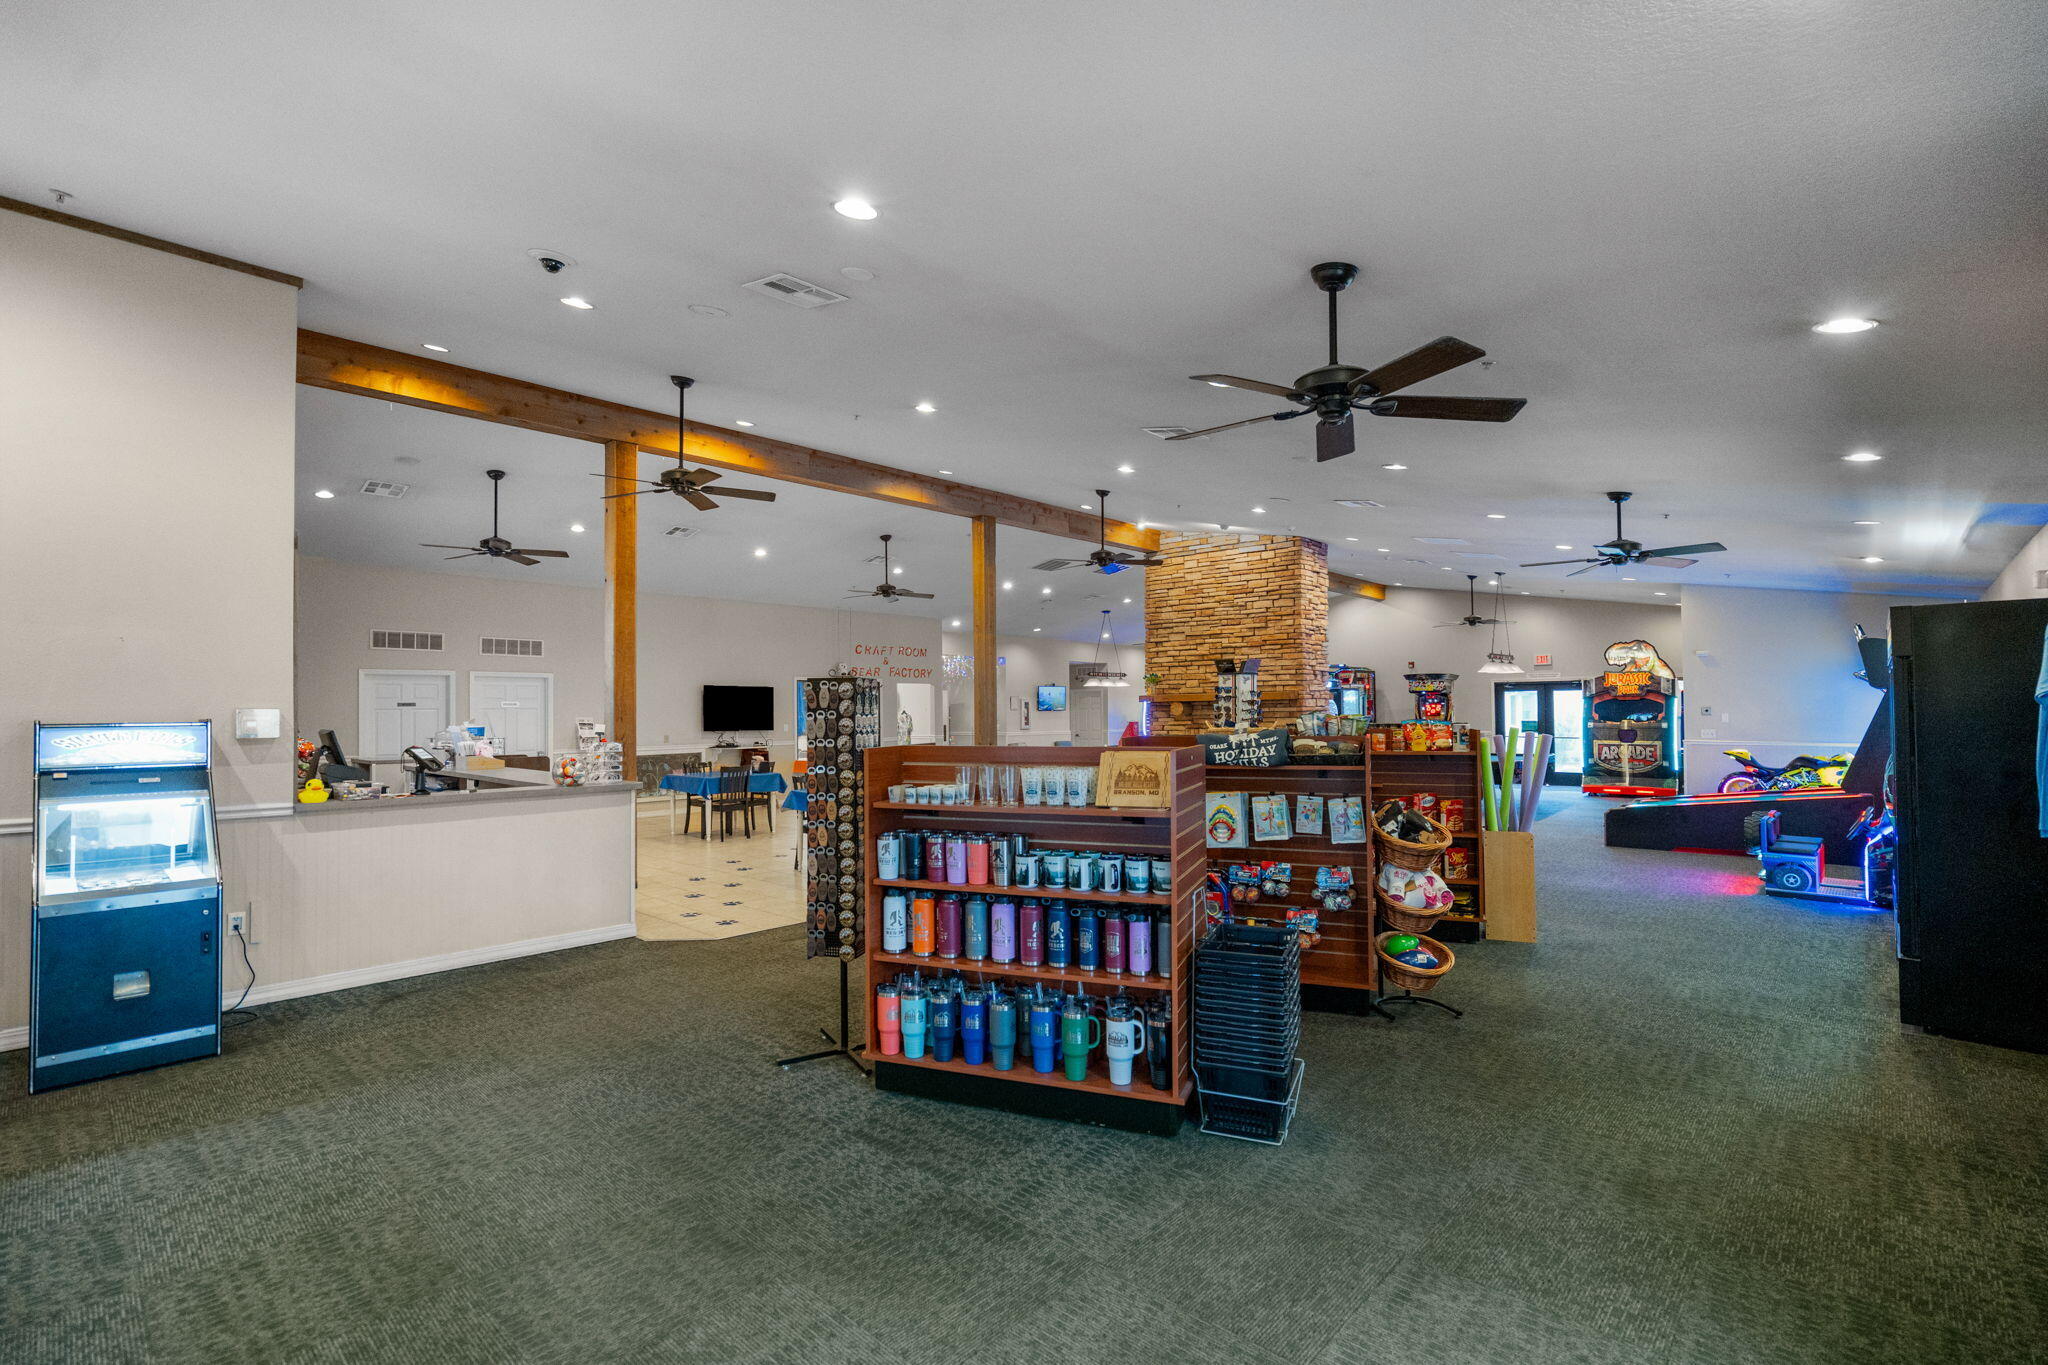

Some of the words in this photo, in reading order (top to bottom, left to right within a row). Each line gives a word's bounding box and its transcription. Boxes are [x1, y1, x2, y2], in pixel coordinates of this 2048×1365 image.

[855, 644, 893, 655] CRAFT
[898, 646, 927, 657] ROOM
[883, 656, 889, 665] &
[851, 666, 880, 677] BEAR
[889, 666, 932, 678] FACTORY
[1604, 672, 1652, 687] JURASSIC
[1617, 684, 1640, 695] PARK
[1209, 742, 1229, 750] OZARK
[1213, 743, 1277, 764] HOLIDAY
[1600, 745, 1656, 761] ARCADE
[1226, 756, 1269, 767] ILLS
